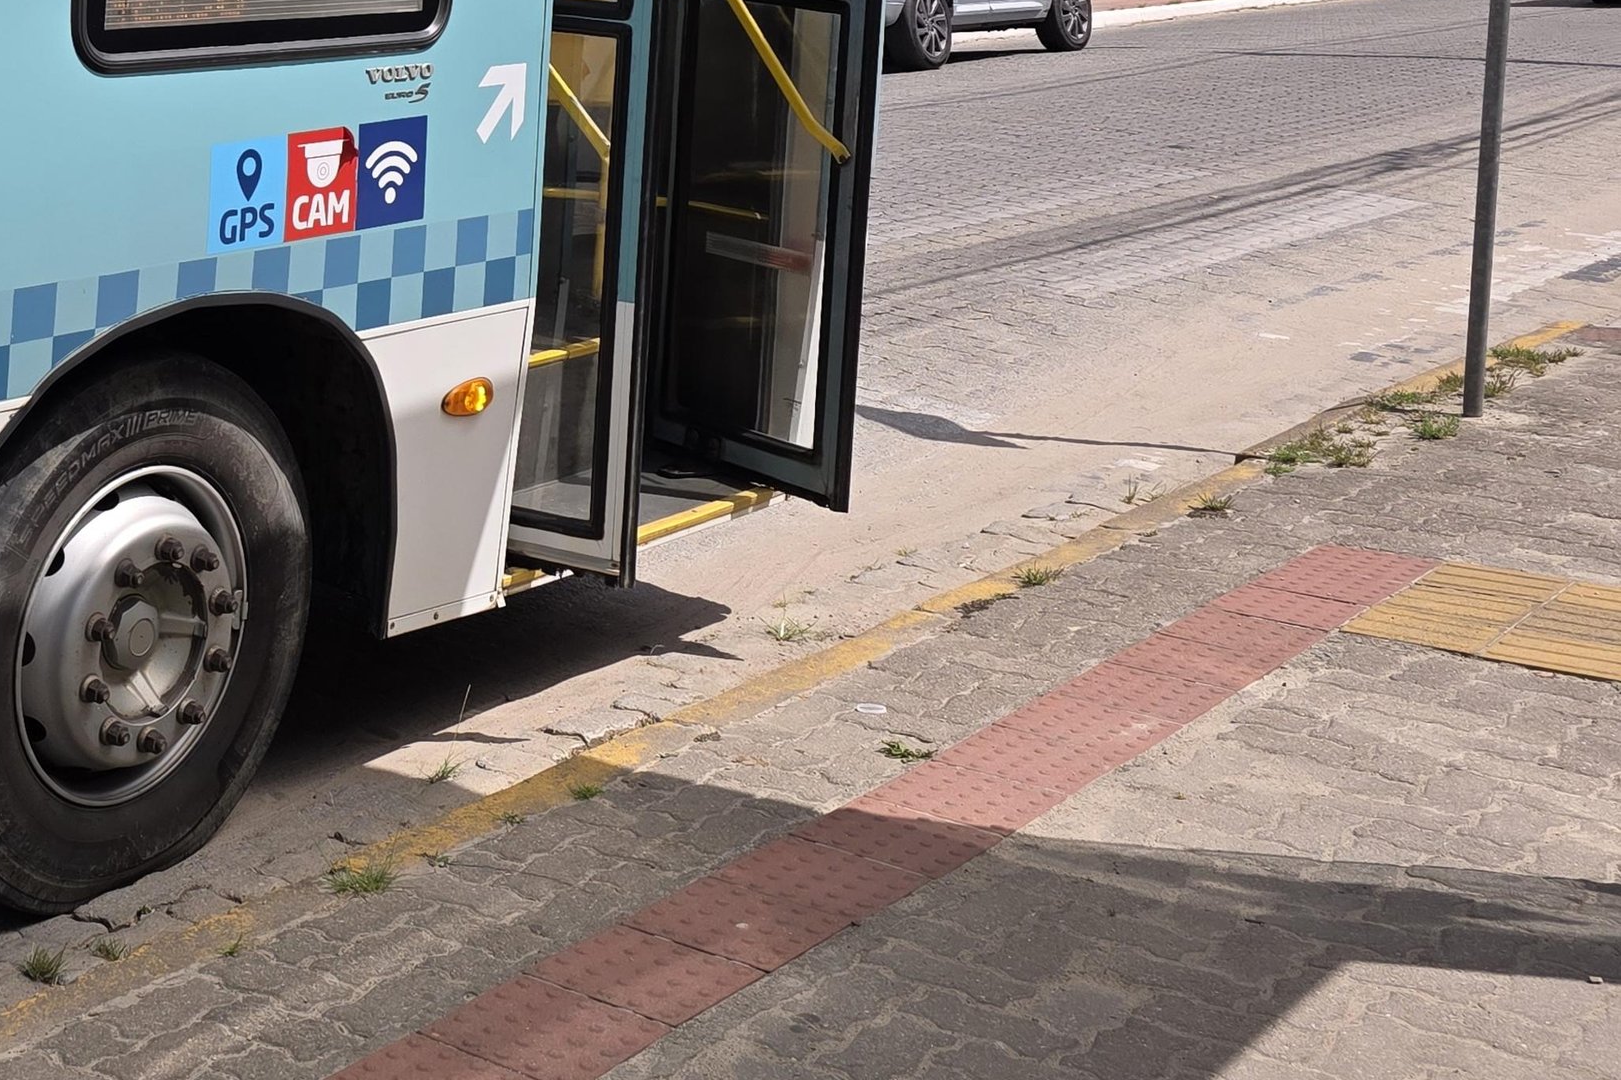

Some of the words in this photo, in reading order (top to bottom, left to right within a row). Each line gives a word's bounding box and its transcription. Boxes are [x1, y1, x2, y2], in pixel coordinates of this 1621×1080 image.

[365, 63, 433, 85] VOLVO
[385, 91, 413, 100] EURO
[292, 189, 351, 230] CAM
[219, 203, 275, 245] GPS
[141, 408, 198, 432] PRIME
